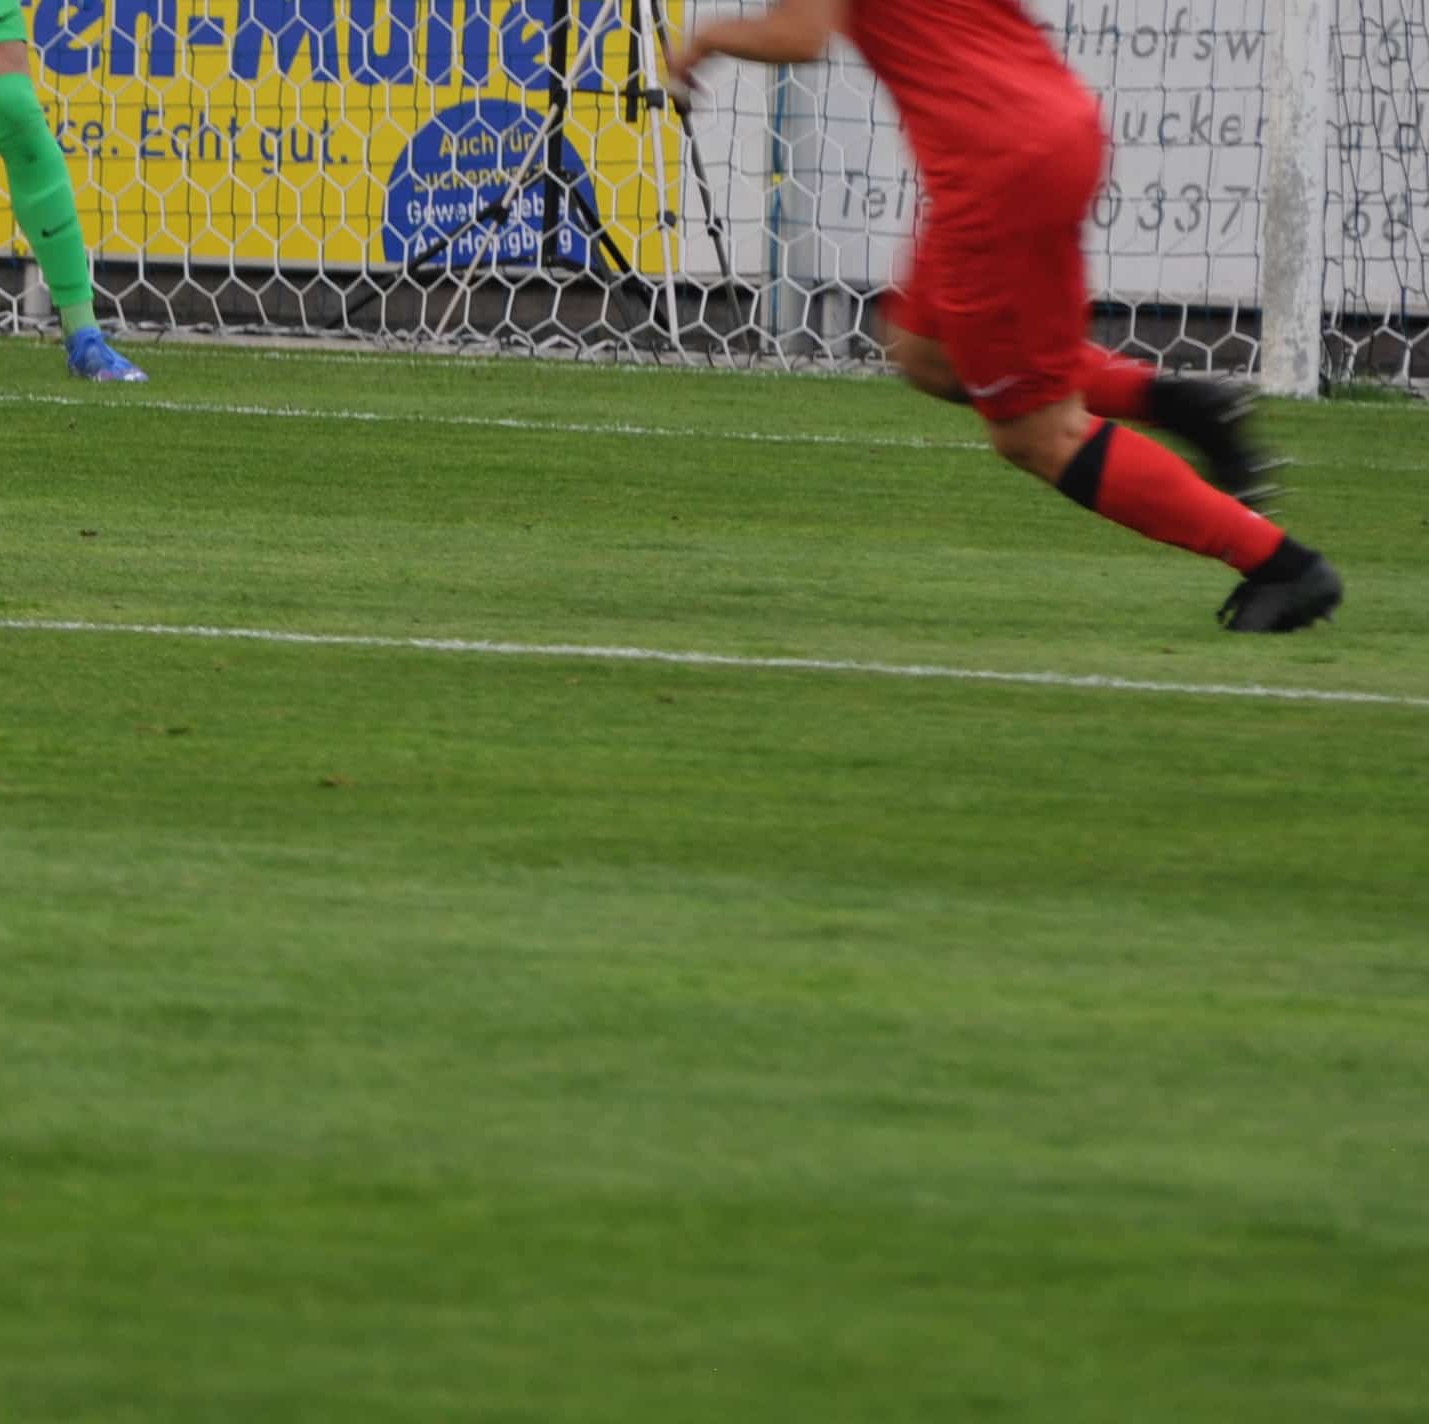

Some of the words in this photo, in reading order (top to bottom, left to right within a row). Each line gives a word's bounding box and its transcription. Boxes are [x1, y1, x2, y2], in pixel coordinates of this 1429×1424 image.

[142, 110, 237, 162] Echt
[260, 118, 350, 175] gut.
[438, 128, 493, 158] Auch
